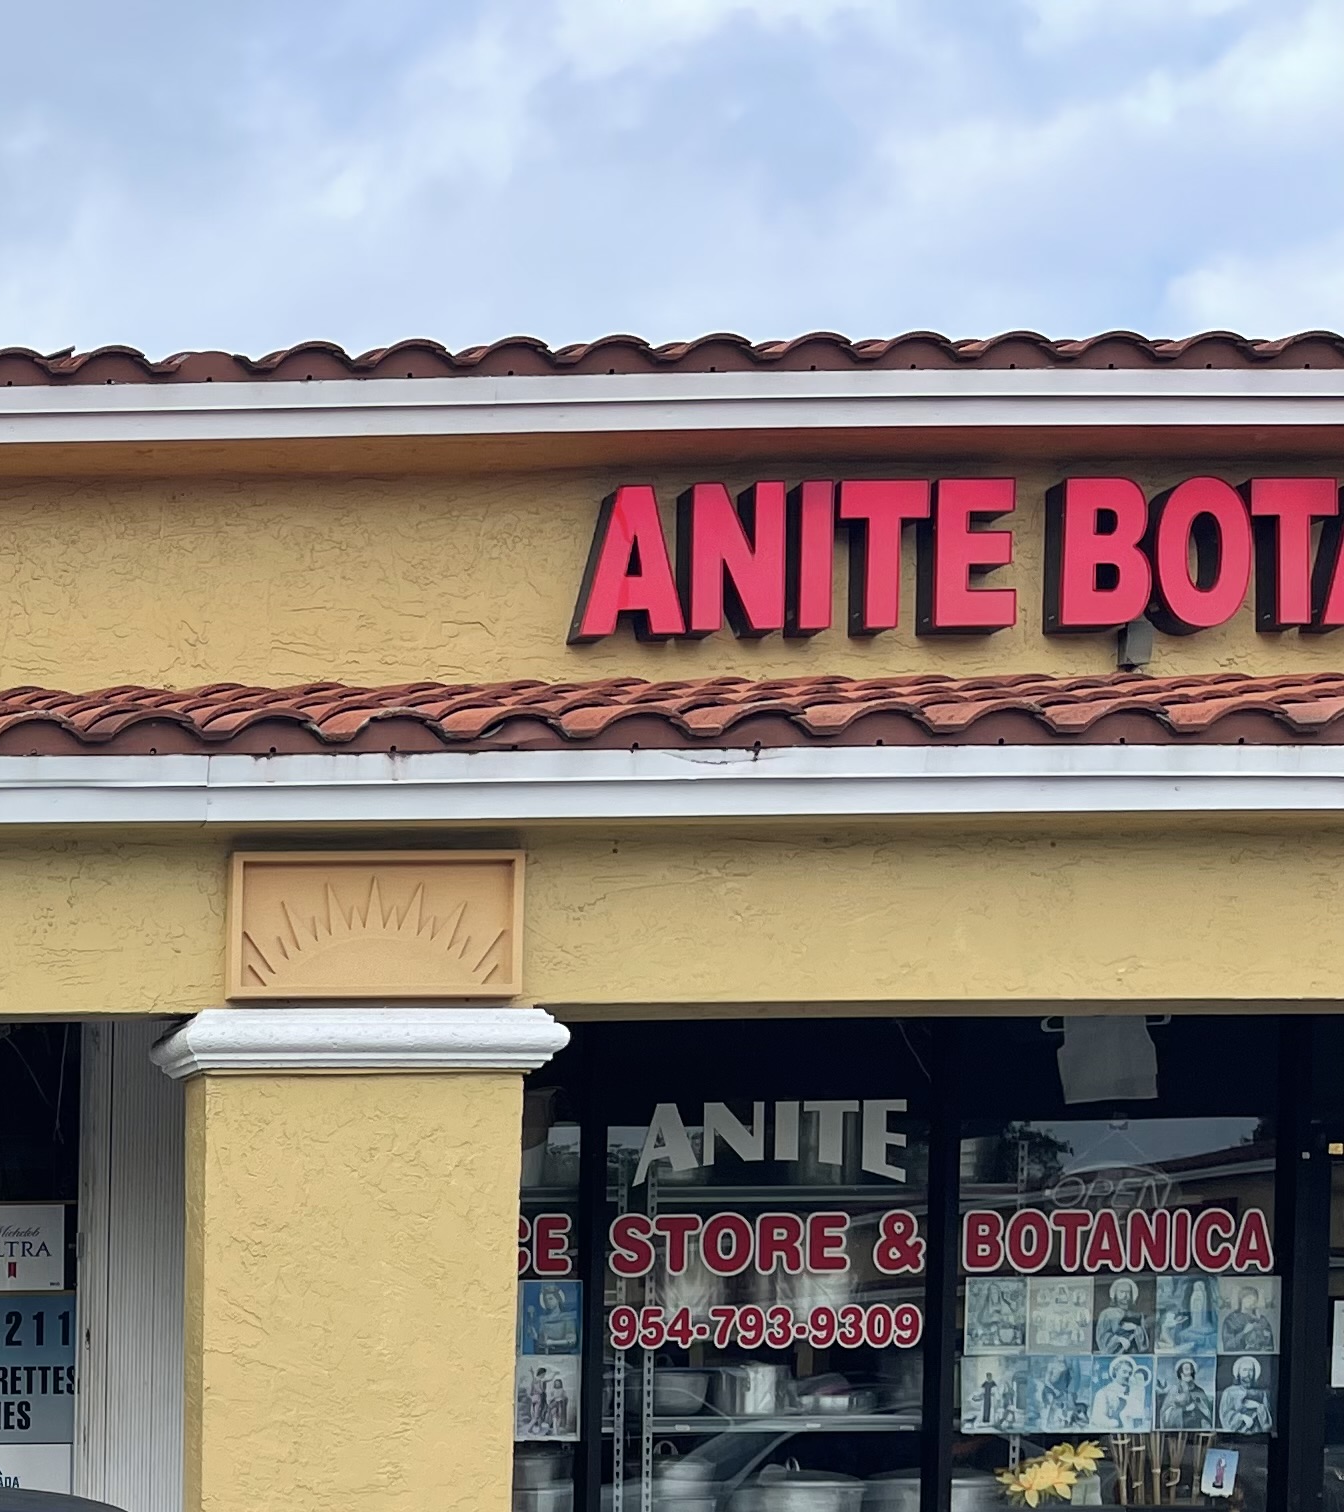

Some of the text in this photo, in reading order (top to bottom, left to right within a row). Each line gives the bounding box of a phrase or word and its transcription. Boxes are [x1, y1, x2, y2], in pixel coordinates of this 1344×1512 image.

[569, 476, 1344, 643] ANITE BOT
[633, 1098, 909, 1187] ANITE
[1052, 1177, 1172, 1208] OPEN
[608, 1212, 852, 1277] STORE
[873, 1209, 927, 1275] &
[961, 1207, 1274, 1275] BOTANICA
[608, 1304, 922, 1350] 954-793-9309
